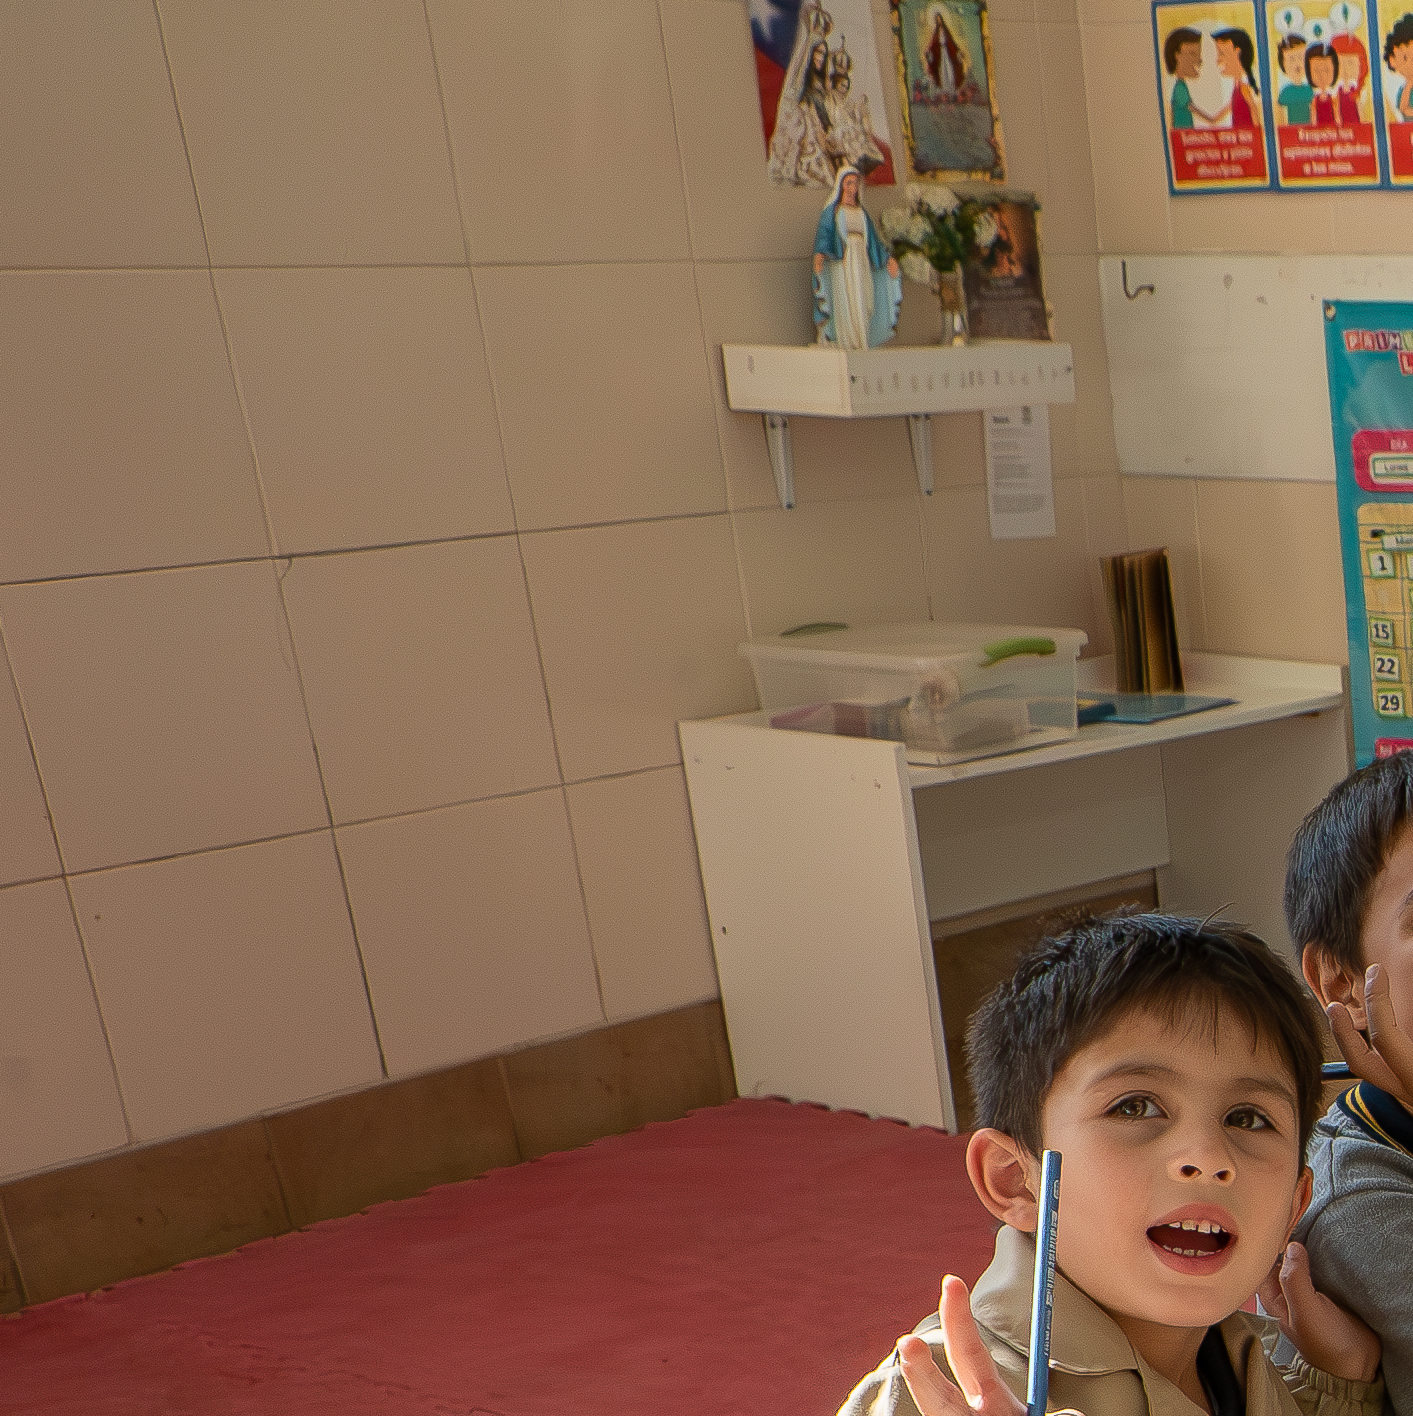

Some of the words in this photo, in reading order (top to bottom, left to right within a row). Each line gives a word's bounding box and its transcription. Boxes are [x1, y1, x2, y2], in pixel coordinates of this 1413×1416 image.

[1378, 555, 1387, 571] 1
[1374, 623, 1390, 640] 15
[1376, 657, 1395, 675] 22
[1380, 694, 1400, 712] 29
